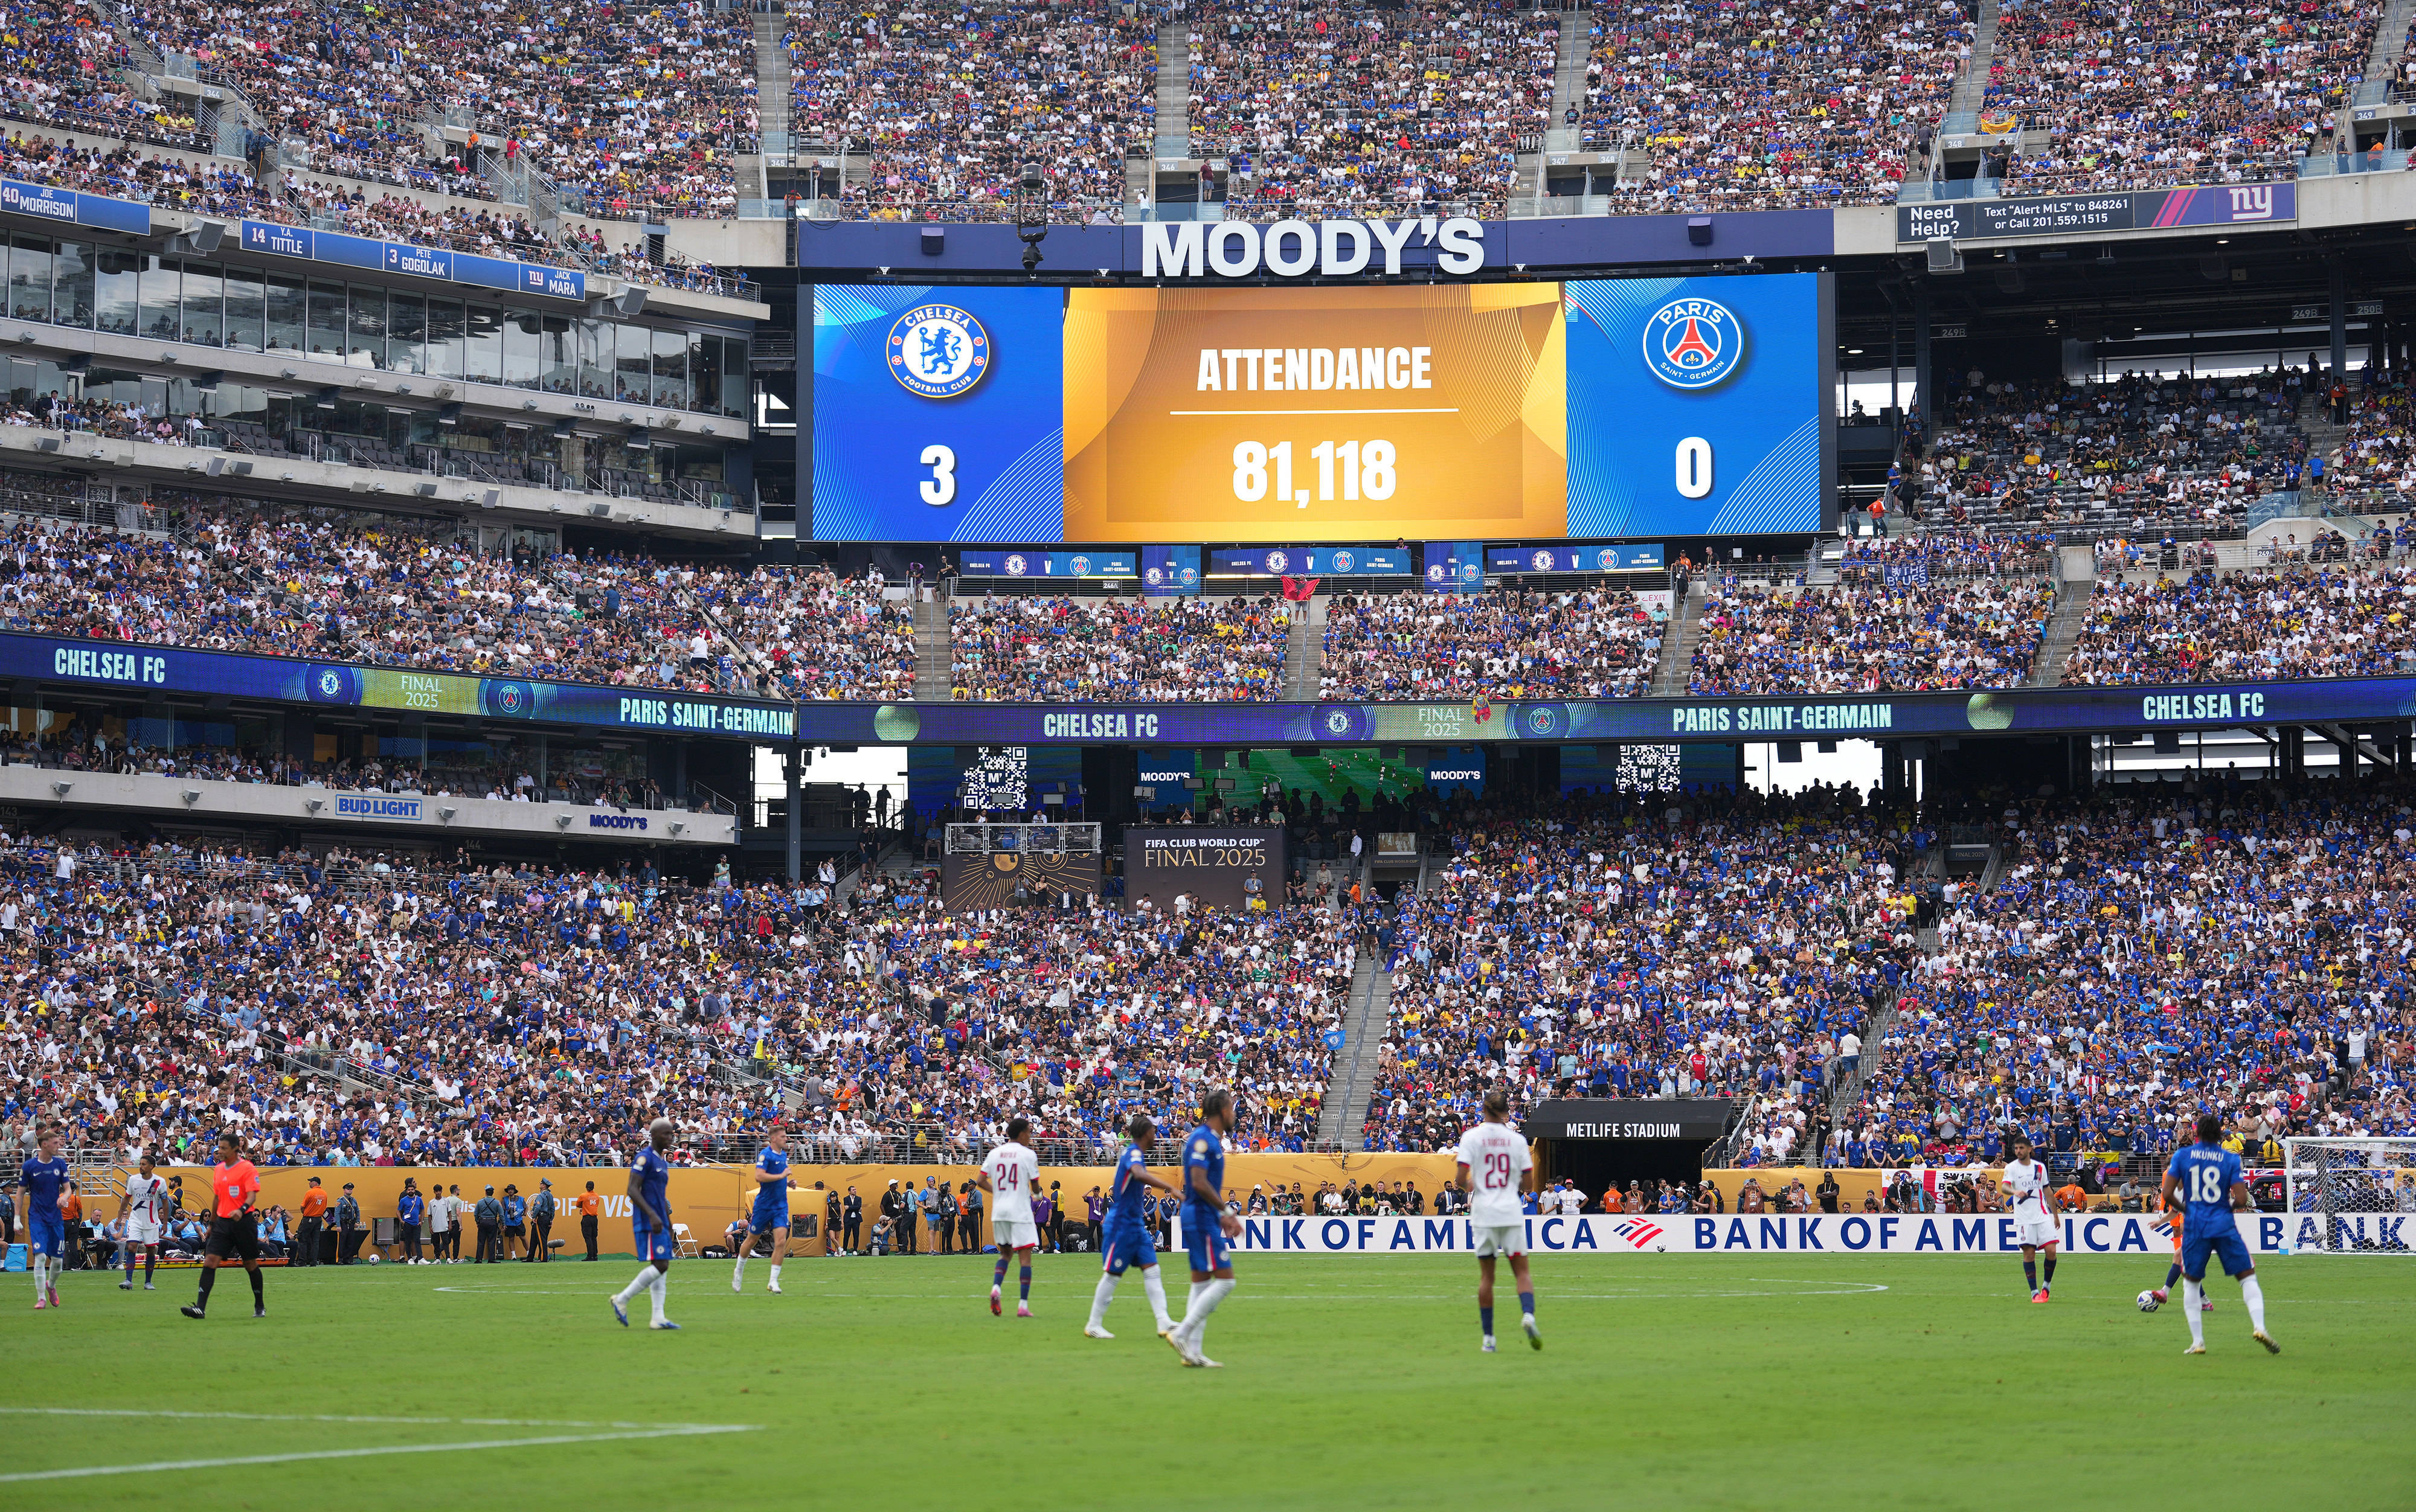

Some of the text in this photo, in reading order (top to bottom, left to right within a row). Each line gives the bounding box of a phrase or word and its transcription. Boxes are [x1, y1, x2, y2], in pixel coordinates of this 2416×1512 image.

[2357, 111, 2373, 120] 349
[484, 138, 495, 147] 345
[2, 187, 19, 203] 40
[40, 189, 53, 199] JOE
[20, 196, 74, 218] MORRISON
[1910, 205, 1954, 221] Need
[1984, 206, 2006, 217] Text
[2076, 202, 2086, 212] to
[2087, 200, 2127, 211] 848261
[1911, 220, 1961, 239] Help?
[1995, 213, 2107, 229] or Call 201.559.1515
[253, 228, 266, 243] 14
[281, 227, 294, 237] Y.A.
[271, 236, 303, 254] TITTLE
[416, 248, 431, 259] PETE
[1142, 219, 1484, 277] MOODY'S
[390, 249, 398, 264] 3
[402, 256, 446, 276] GOGOLAK
[555, 270, 571, 281] JACK
[549, 279, 576, 296] MARA
[904, 306, 971, 329] CHELSEA
[1659, 299, 1724, 327] PARIS
[2293, 309, 2317, 319] 249B
[2357, 305, 2382, 314] 250B
[1198, 347, 1431, 391] ATTENDANCE
[1659, 360, 1725, 381] SAINT GERMAIN
[904, 374, 972, 394] FOOTBALL CLUB
[920, 445, 955, 505] 3
[1233, 439, 1396, 508] 81,118
[1675, 437, 1711, 498] 0
[1044, 560, 1052, 574] V
[1306, 556, 1313, 569] V
[1572, 555, 1579, 569] V
[1903, 563, 1926, 574] THE
[1169, 571, 1174, 580] V
[1887, 573, 1927, 586] BLUES
[1648, 594, 1666, 602] EXIT
[55, 648, 165, 684] CHELSEA FC
[401, 674, 442, 693] FINAL
[405, 691, 439, 708] 2025
[2143, 692, 2264, 720] CHELSEA FC
[620, 697, 793, 735] PARIS SAINT-GERMAIN
[1418, 708, 1465, 722] FINAL
[1673, 704, 1892, 731] PARIS SAINT-GERMAIN
[1044, 713, 1158, 738] CHELSEA FC
[1424, 722, 1461, 737] 2025
[1141, 772, 1190, 781] MOODY'S
[1431, 770, 1481, 780] MOODY'S
[338, 798, 419, 818] BUD LIGHT
[590, 814, 647, 830] MOODY'S
[1145, 839, 1168, 848] FIFA
[1170, 839, 1196, 848] CLUB
[1198, 839, 1237, 847] WORLD
[1145, 848, 1266, 867] FINAL 2025
[1567, 1123, 1680, 1138] METLIFE STADIUM
[2190, 1150, 2225, 1163] NKUNKU
[997, 1163, 1018, 1191] 24
[1485, 1153, 1510, 1188] 29
[2190, 1165, 2221, 1203] 18
[1322, 1219, 1376, 1250] OF
[1695, 1217, 2148, 1251] BANK OF AMEICA
[2260, 1217, 2408, 1251] BANK
